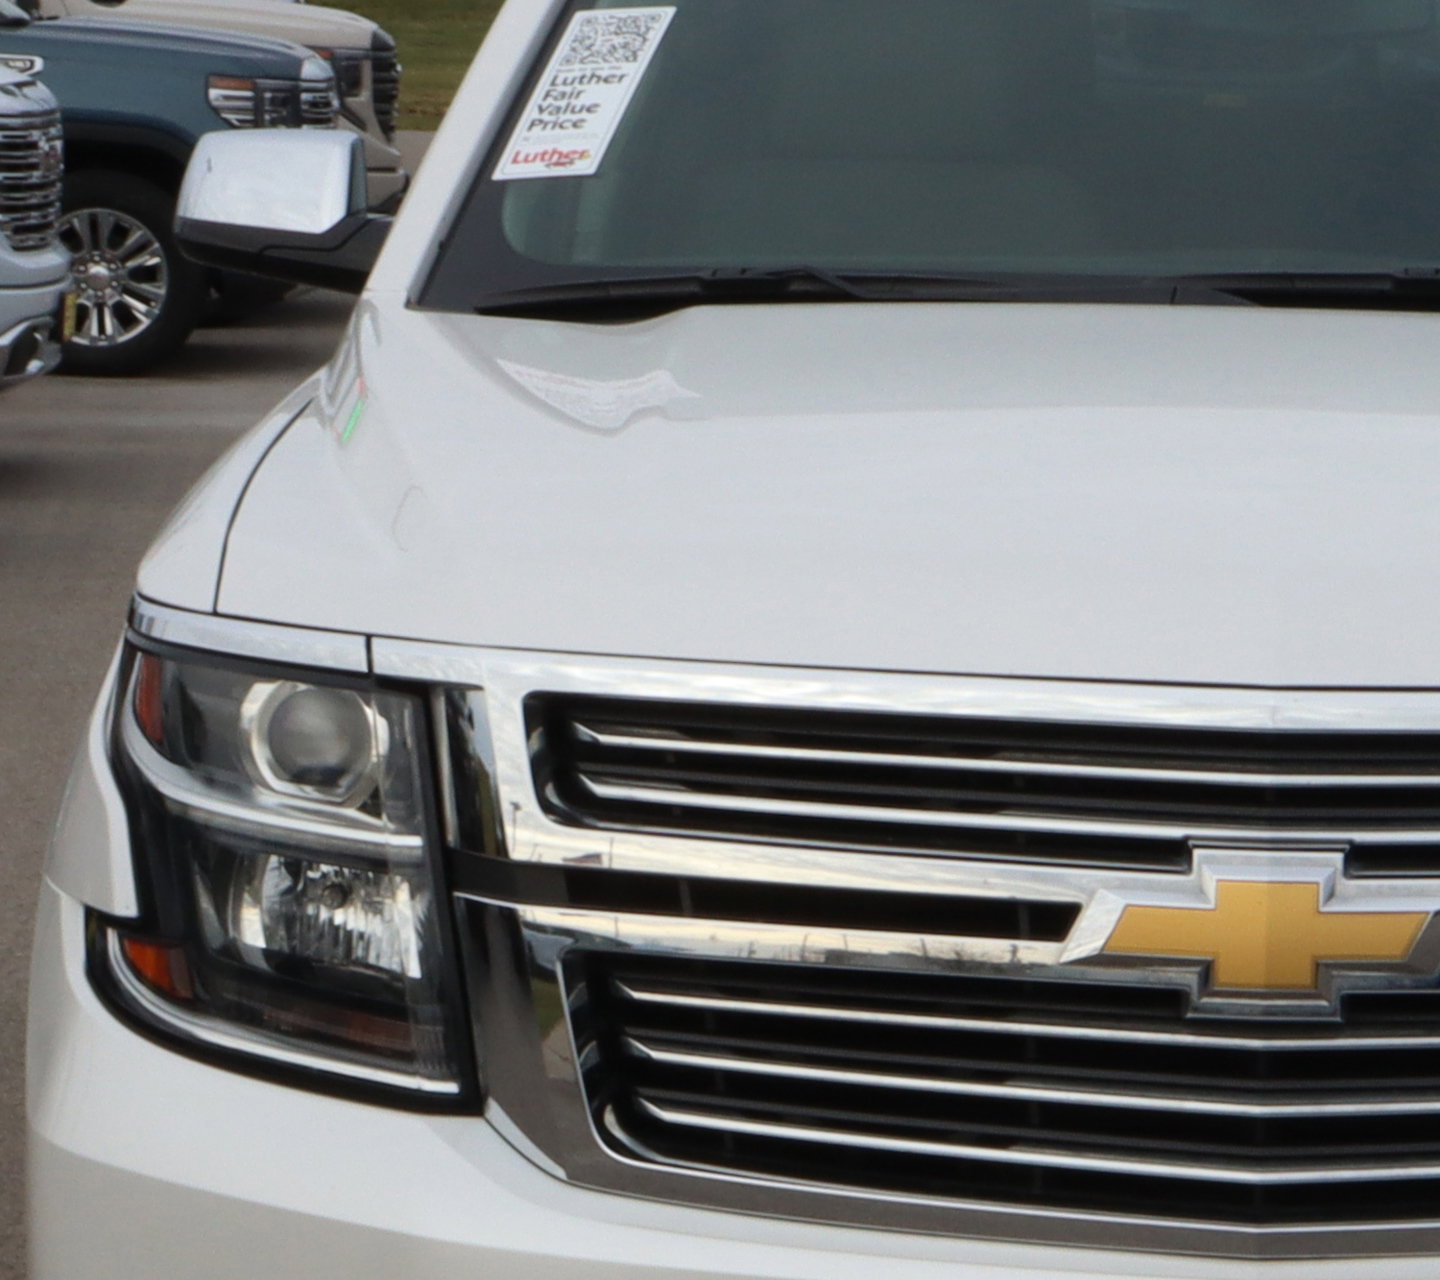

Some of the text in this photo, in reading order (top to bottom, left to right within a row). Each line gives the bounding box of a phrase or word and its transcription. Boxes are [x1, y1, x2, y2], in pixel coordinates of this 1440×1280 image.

[550, 71, 629, 87] Luther
[541, 87, 586, 102] Fair
[537, 101, 601, 117] Value
[526, 117, 587, 132] Price
[511, 147, 590, 165] Luther
